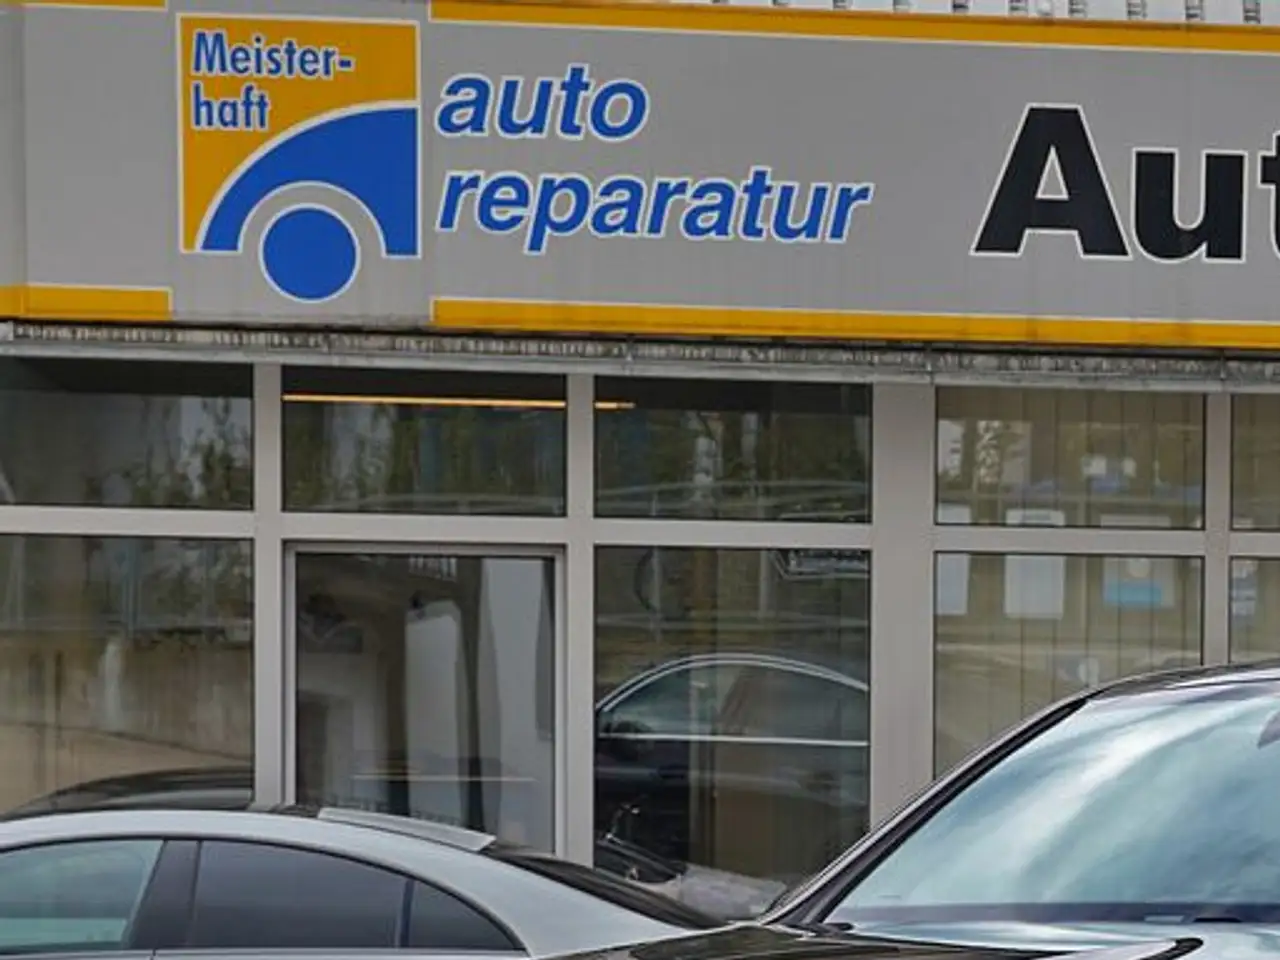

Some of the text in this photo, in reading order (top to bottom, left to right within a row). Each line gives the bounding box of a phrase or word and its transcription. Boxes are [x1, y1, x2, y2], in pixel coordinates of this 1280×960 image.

[193, 32, 352, 77] Meister-
[193, 83, 268, 129] haft
[438, 67, 646, 138] auto
[439, 169, 869, 252] reparatur
